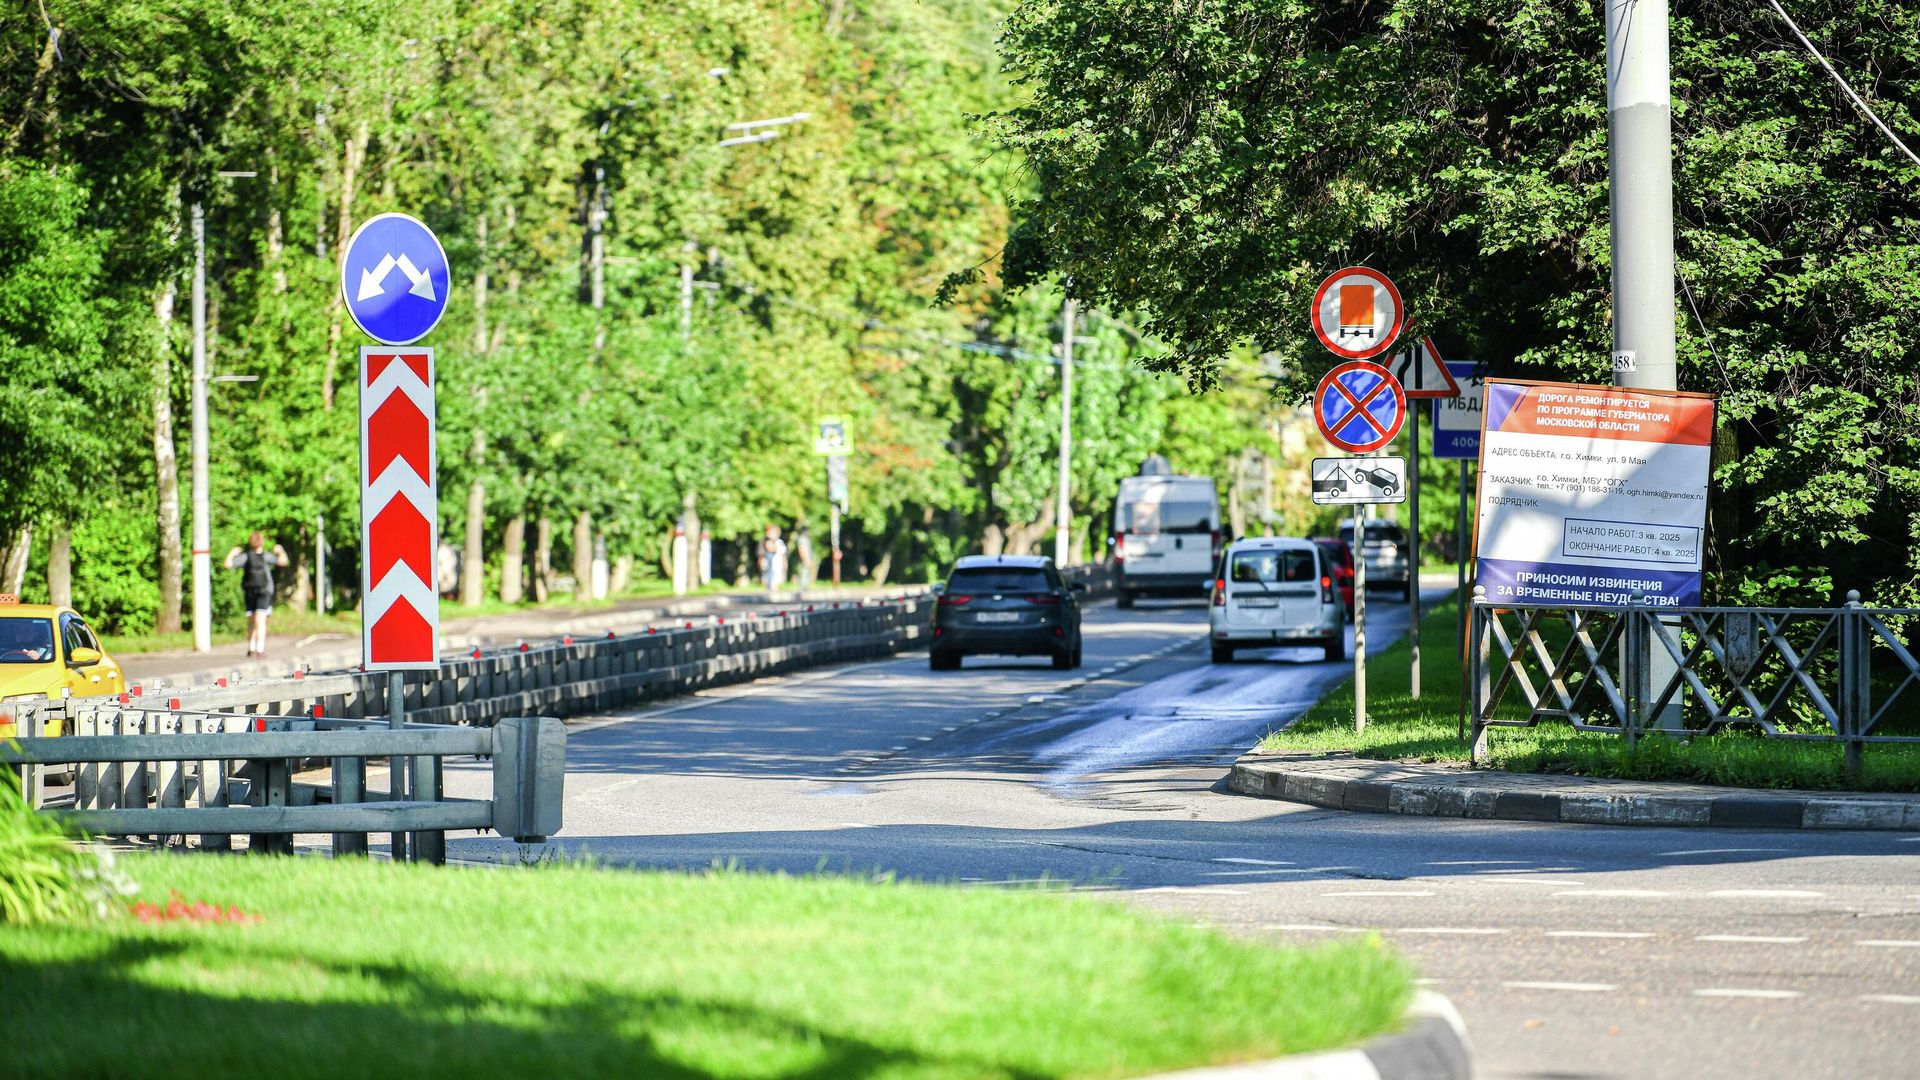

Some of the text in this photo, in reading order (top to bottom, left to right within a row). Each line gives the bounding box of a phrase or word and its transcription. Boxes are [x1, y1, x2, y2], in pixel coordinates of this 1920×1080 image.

[1614, 355, 1630, 370] 458
[1538, 393, 1650, 409] ДОРОГА РЕМОНТИРУЕТСЯ
[1537, 404, 1670, 423] ПО ПРОГРАММЕ ГУБЕРНАТОРА
[1536, 416, 1641, 433] МОСКОВСКОЙ ОБЛАСТИ
[1491, 447, 1518, 457] АДРЕС
[1519, 448, 1559, 460] ОБЪЕКТА:
[1621, 455, 1628, 464] 9
[1628, 456, 1647, 465] Мая
[1489, 474, 1534, 486] ЗАКАЗЧИК:
[1582, 476, 1602, 485] МБУ
[1603, 477, 1629, 487] "ОГХ"
[1555, 483, 1566, 491] +7
[1566, 483, 1586, 494] (901)
[1588, 485, 1625, 496] 186-31-19,
[1626, 488, 1705, 501] ogh.himki@yandex.ru
[1488, 495, 1540, 508] ПОДРЯДЧИК:
[1570, 525, 1607, 537] НАЧАЛО
[1659, 533, 1681, 542] 2025
[1569, 541, 1623, 554] ОКОНЧАНИЕ
[1675, 549, 1696, 558] 2025
[1516, 571, 1663, 592] ПРИНОСИМ ИЗВИНЕНИЯ
[1496, 585, 1680, 607] ЗА ВРЕМЕННЫЕ НЕУДСТВА!
